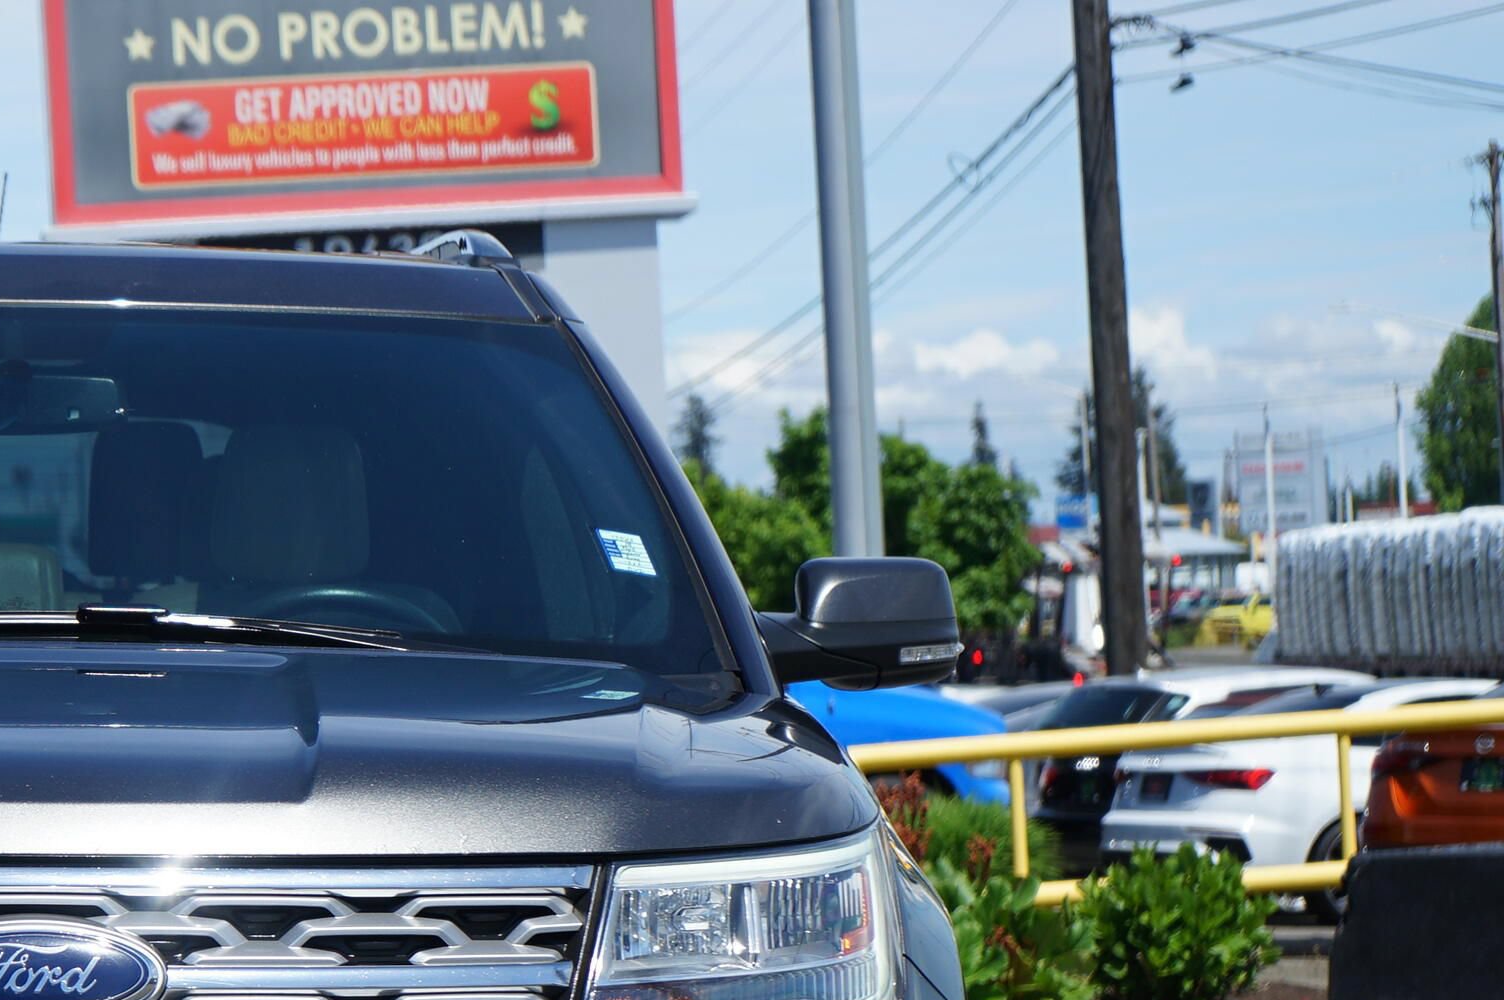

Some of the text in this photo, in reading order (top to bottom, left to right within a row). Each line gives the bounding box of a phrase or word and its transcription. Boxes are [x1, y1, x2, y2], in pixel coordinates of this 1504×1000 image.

[171, 0, 545, 67] NO PROBLEM!
[234, 77, 489, 125] GET APPROVED NOW
[228, 111, 500, 147] BAD CREDIT WE CAN HELP
